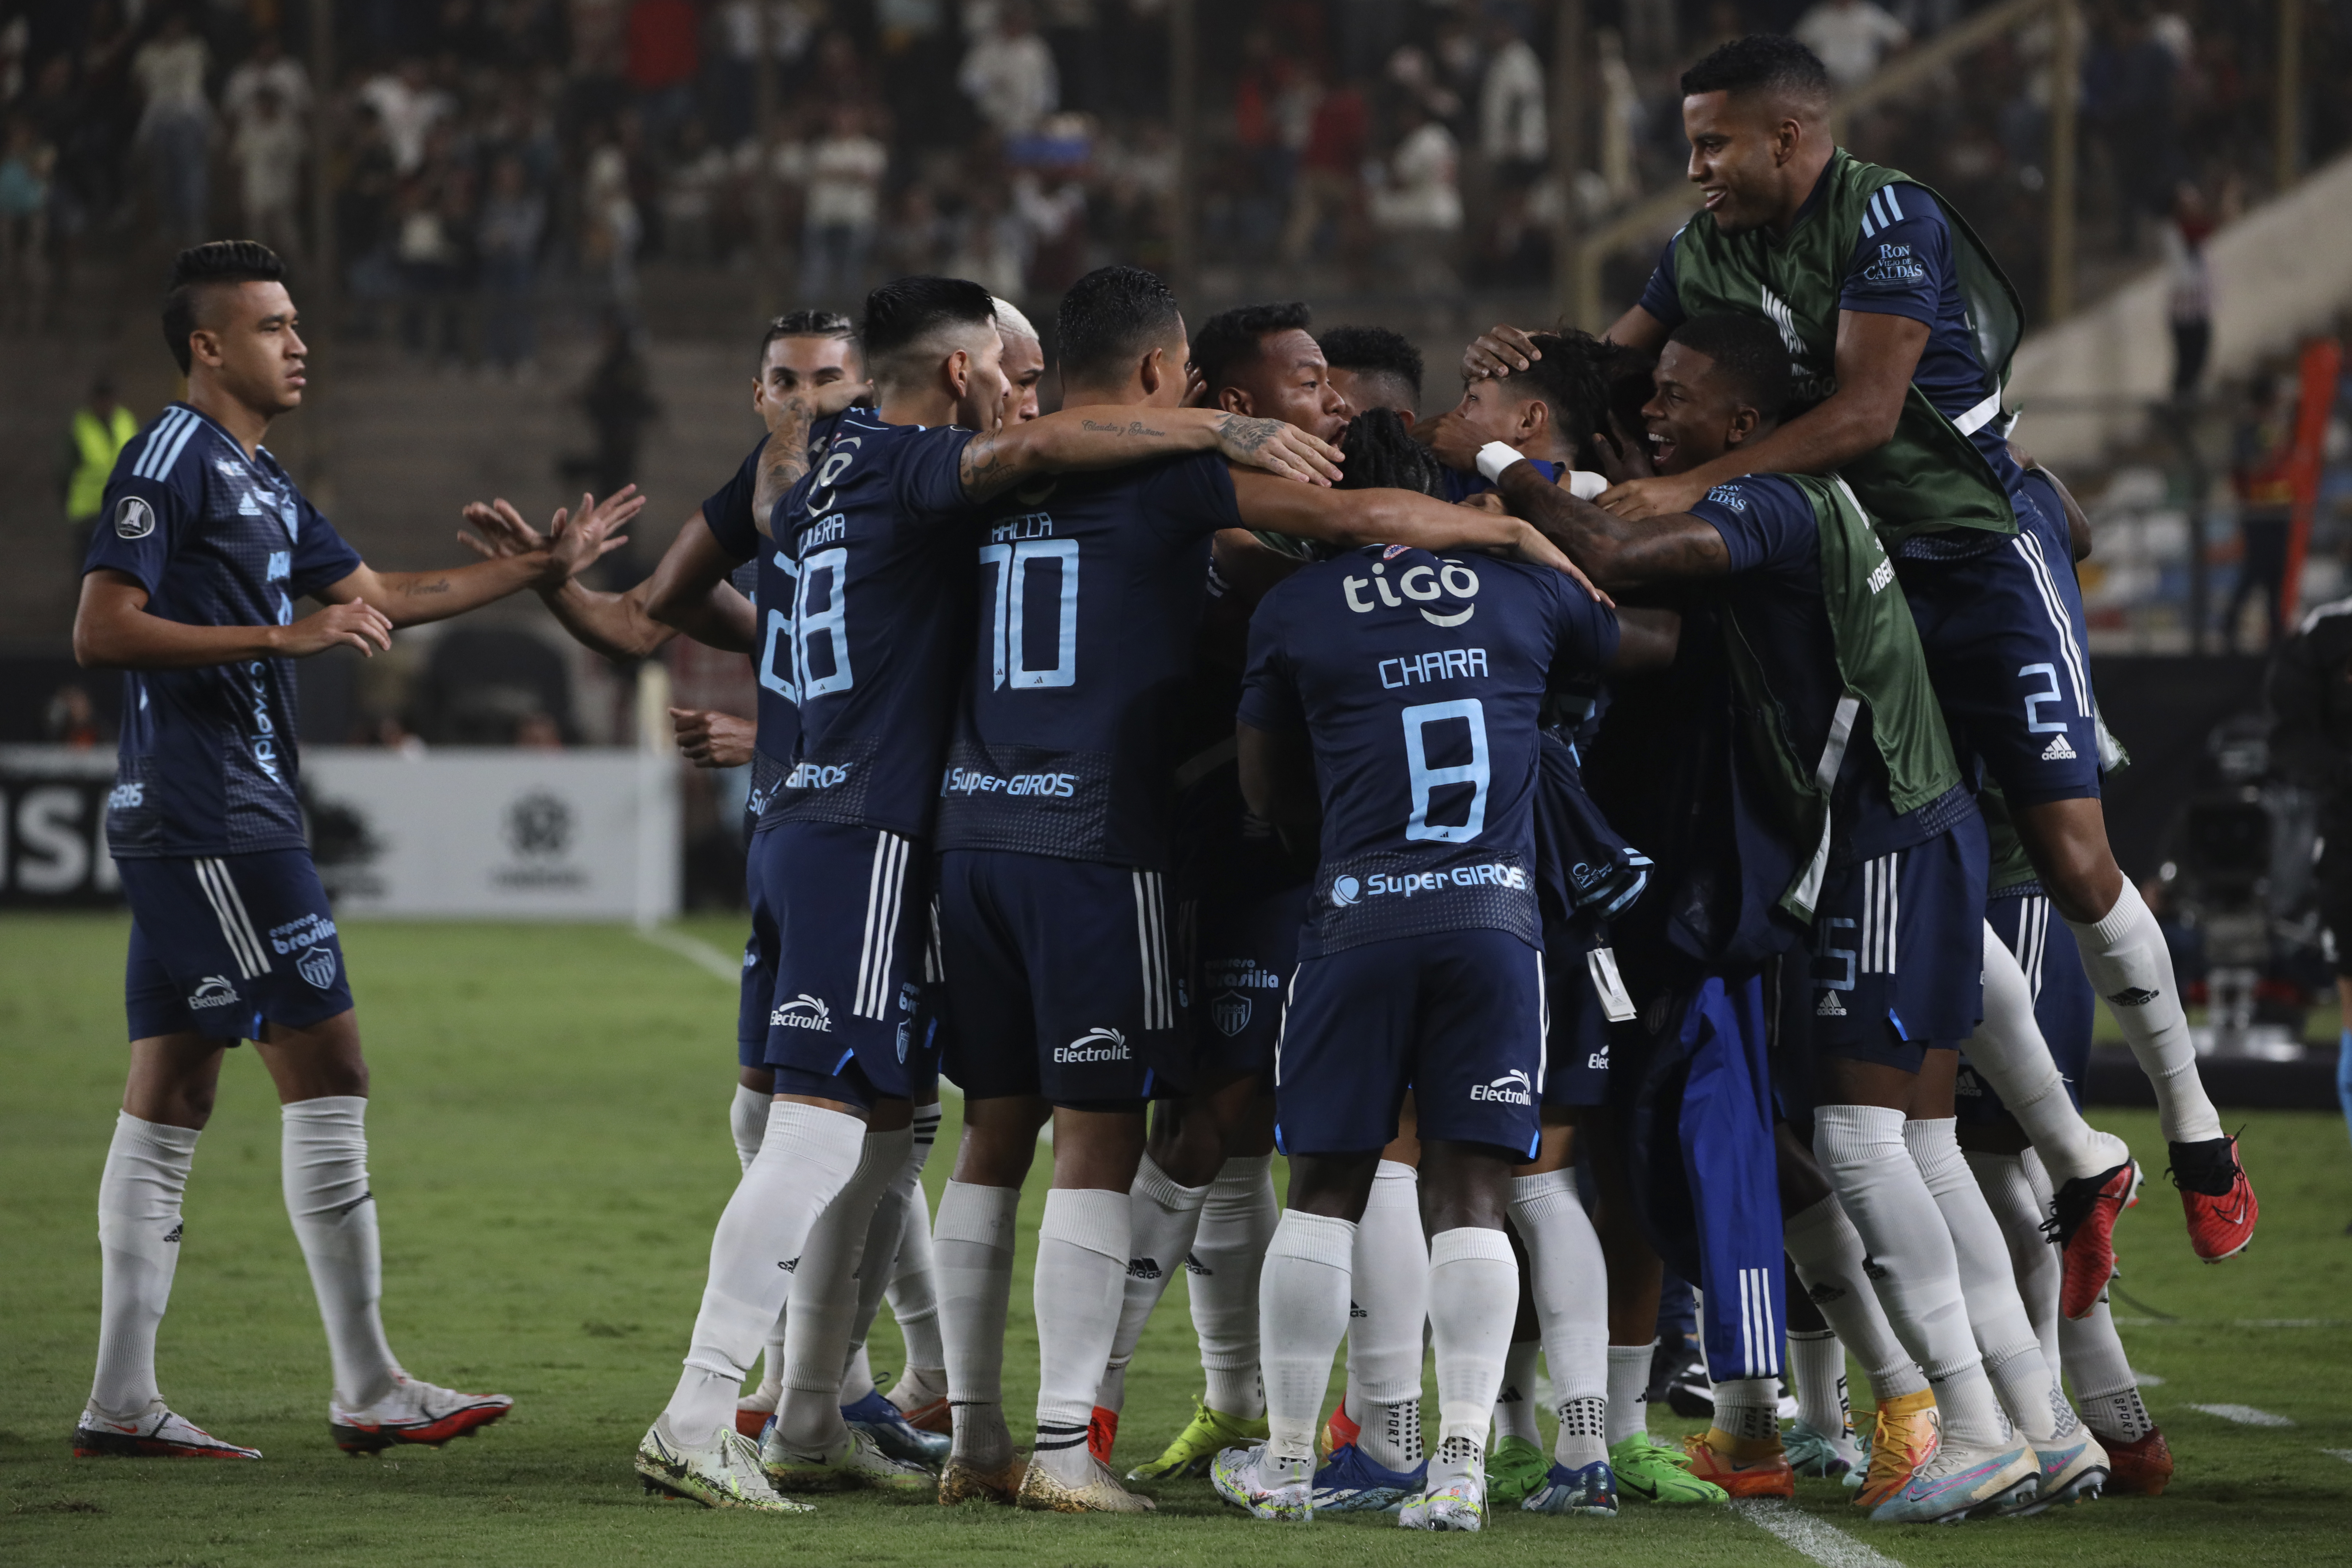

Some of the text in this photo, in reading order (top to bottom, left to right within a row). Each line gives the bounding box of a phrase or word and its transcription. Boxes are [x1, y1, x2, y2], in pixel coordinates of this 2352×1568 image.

[1864, 264, 1922, 280] CALDAS
[1128, 421, 1165, 437] Gustavo
[1708, 492, 1747, 511] LDAS
[1378, 648, 1488, 689] CHARA
[2018, 663, 2068, 733] 2
[2042, 750, 2077, 761] adidas
[1402, 698, 1490, 843] 8
[1204, 969, 1279, 988] brasilia
[1816, 1007, 1847, 1016] adidas
[770, 1010, 832, 1033] Electrolit
[1054, 1045, 1131, 1063] Electrolit
[2114, 1398, 2136, 1438] SPORT
